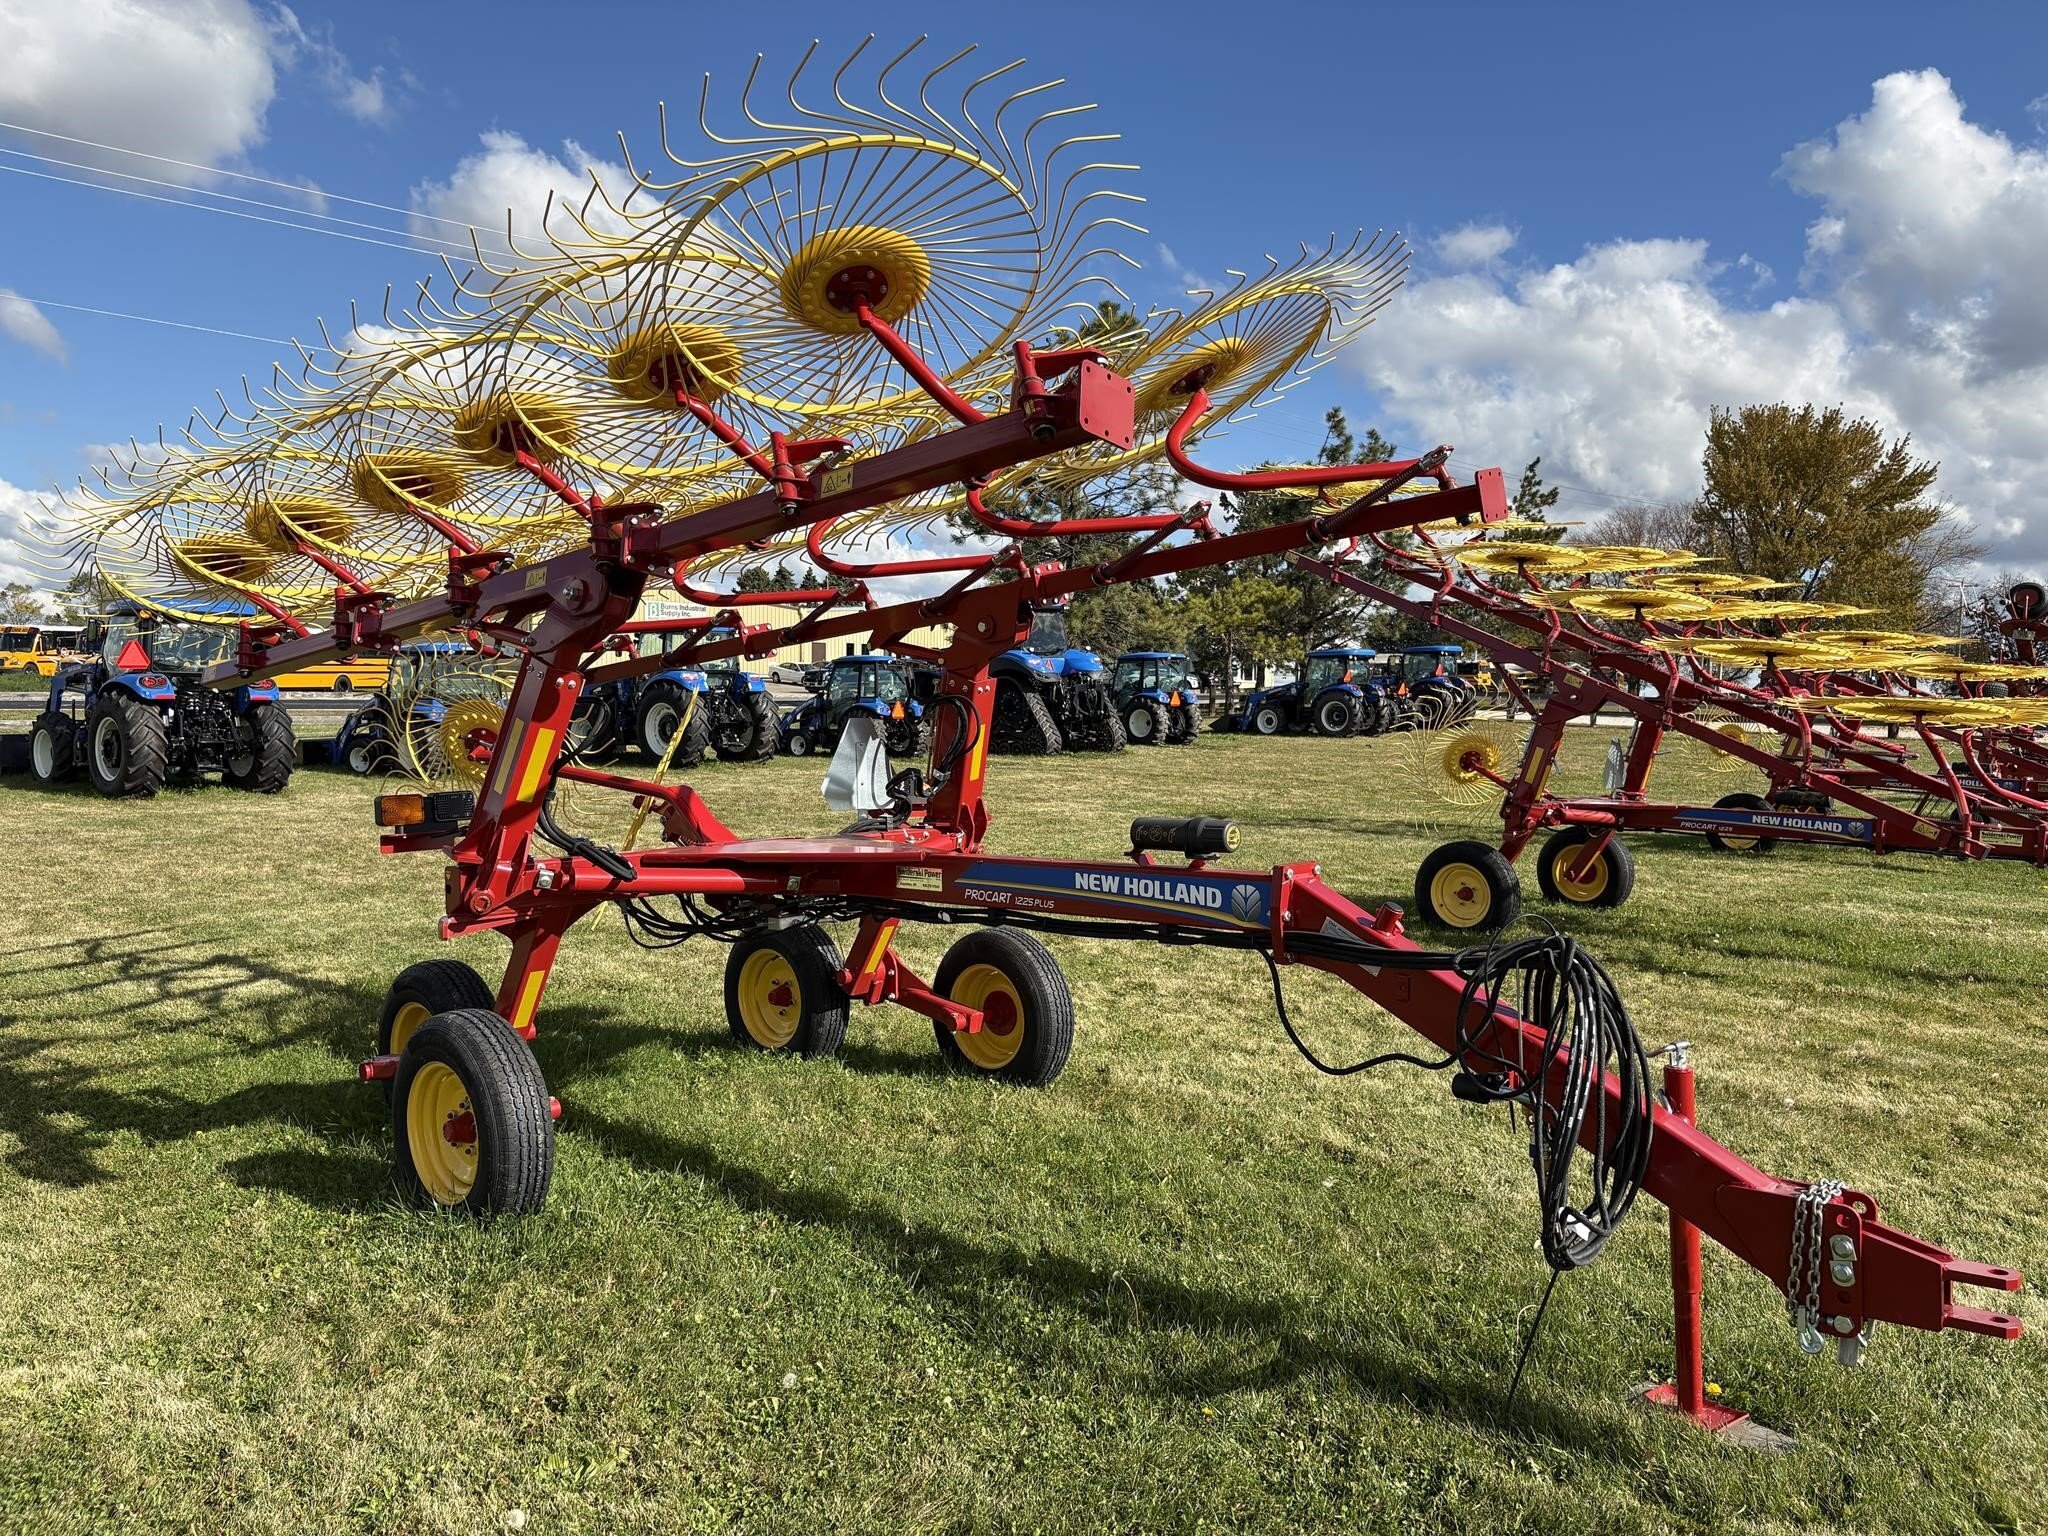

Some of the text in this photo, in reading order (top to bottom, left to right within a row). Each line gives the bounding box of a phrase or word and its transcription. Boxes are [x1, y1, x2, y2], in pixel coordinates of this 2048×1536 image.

[680, 604, 706, 612] Industrial
[1680, 821, 1717, 830] PROCART
[1752, 814, 1843, 833] NEW HOLLAND
[924, 868, 942, 879] Power
[1075, 872, 1222, 908] NEW HOLLAND
[964, 888, 1055, 909] PROCART 1225 PLUS
